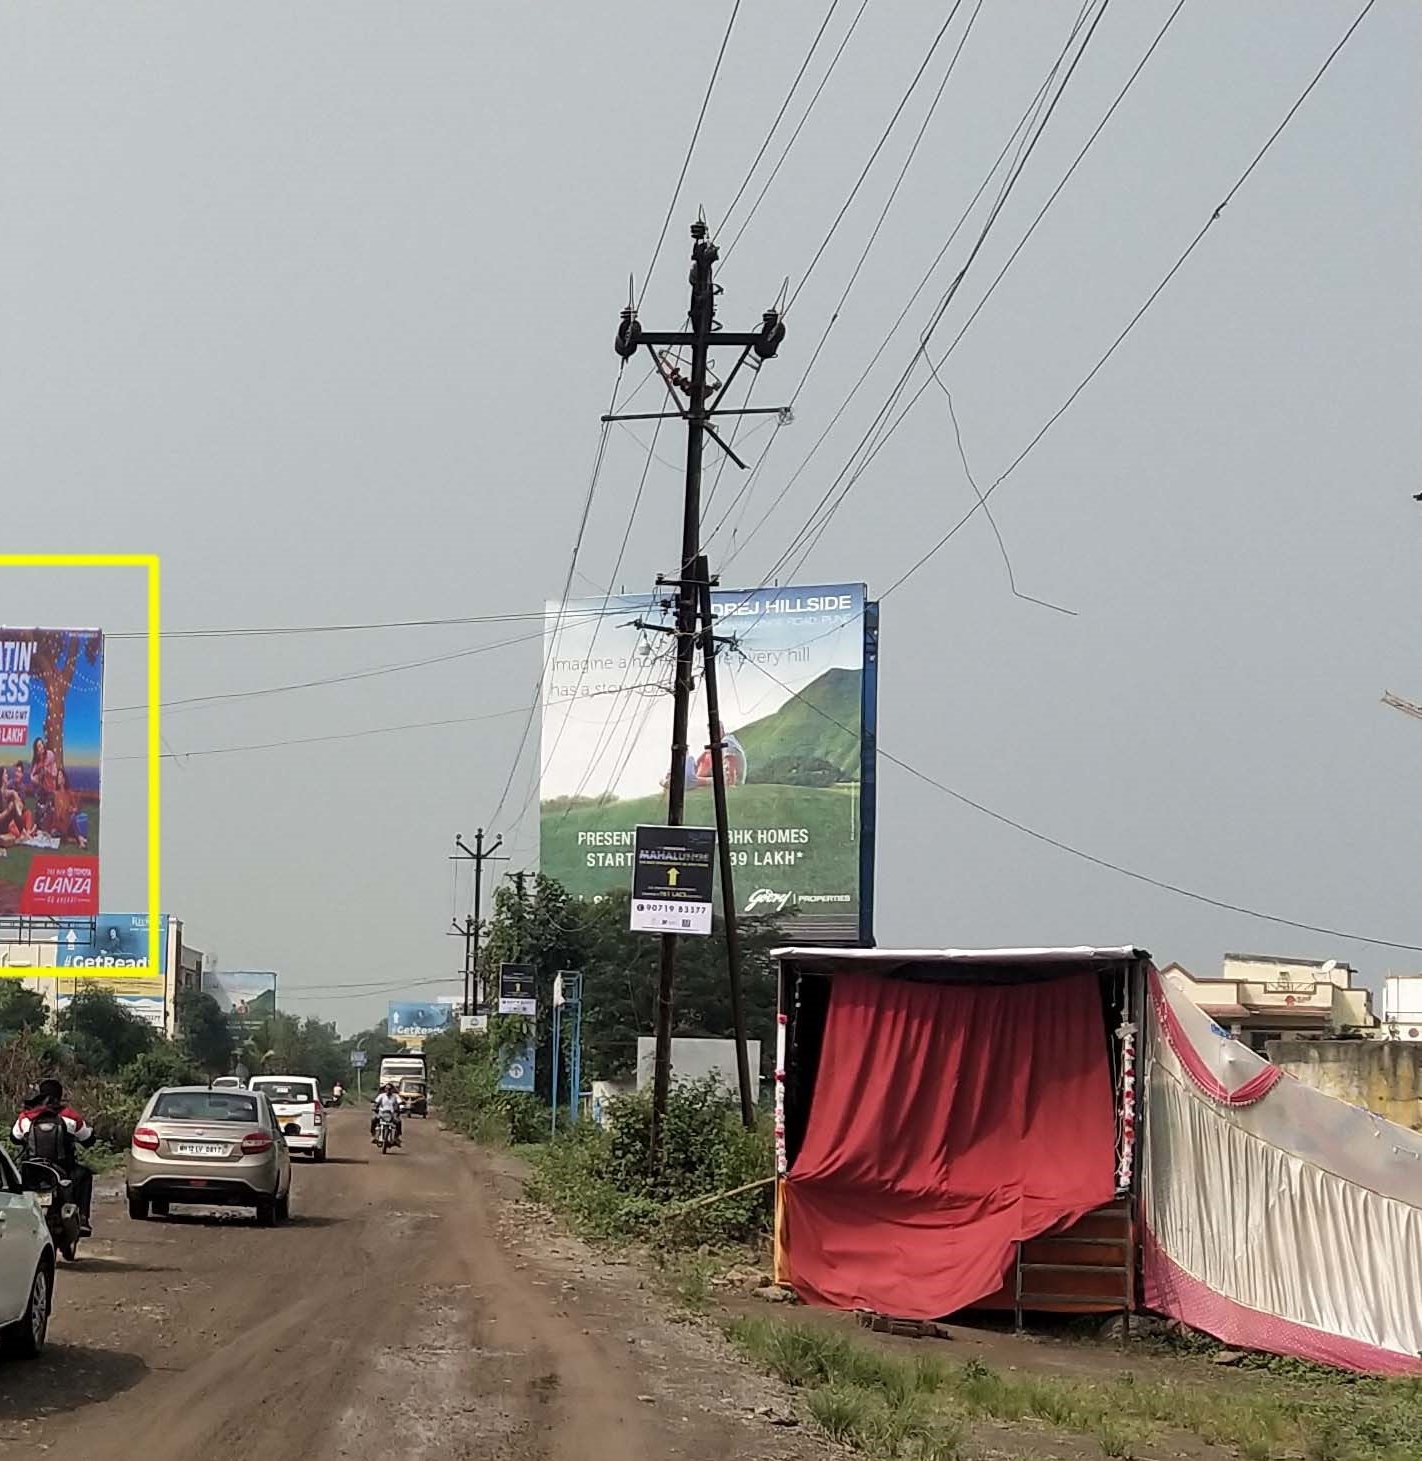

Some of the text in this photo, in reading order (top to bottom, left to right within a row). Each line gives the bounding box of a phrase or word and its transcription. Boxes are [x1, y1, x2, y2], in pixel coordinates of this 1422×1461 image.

[765, 595, 851, 613] HILLSIDE
[552, 657, 613, 674] Imagine
[618, 658, 626, 668] a
[787, 647, 810, 663] hill
[551, 683, 576, 696] has
[758, 829, 809, 844] HOMES
[33, 875, 92, 895] GLANZA
[646, 904, 675, 912] 90719
[64, 956, 151, 968] #GetRead
